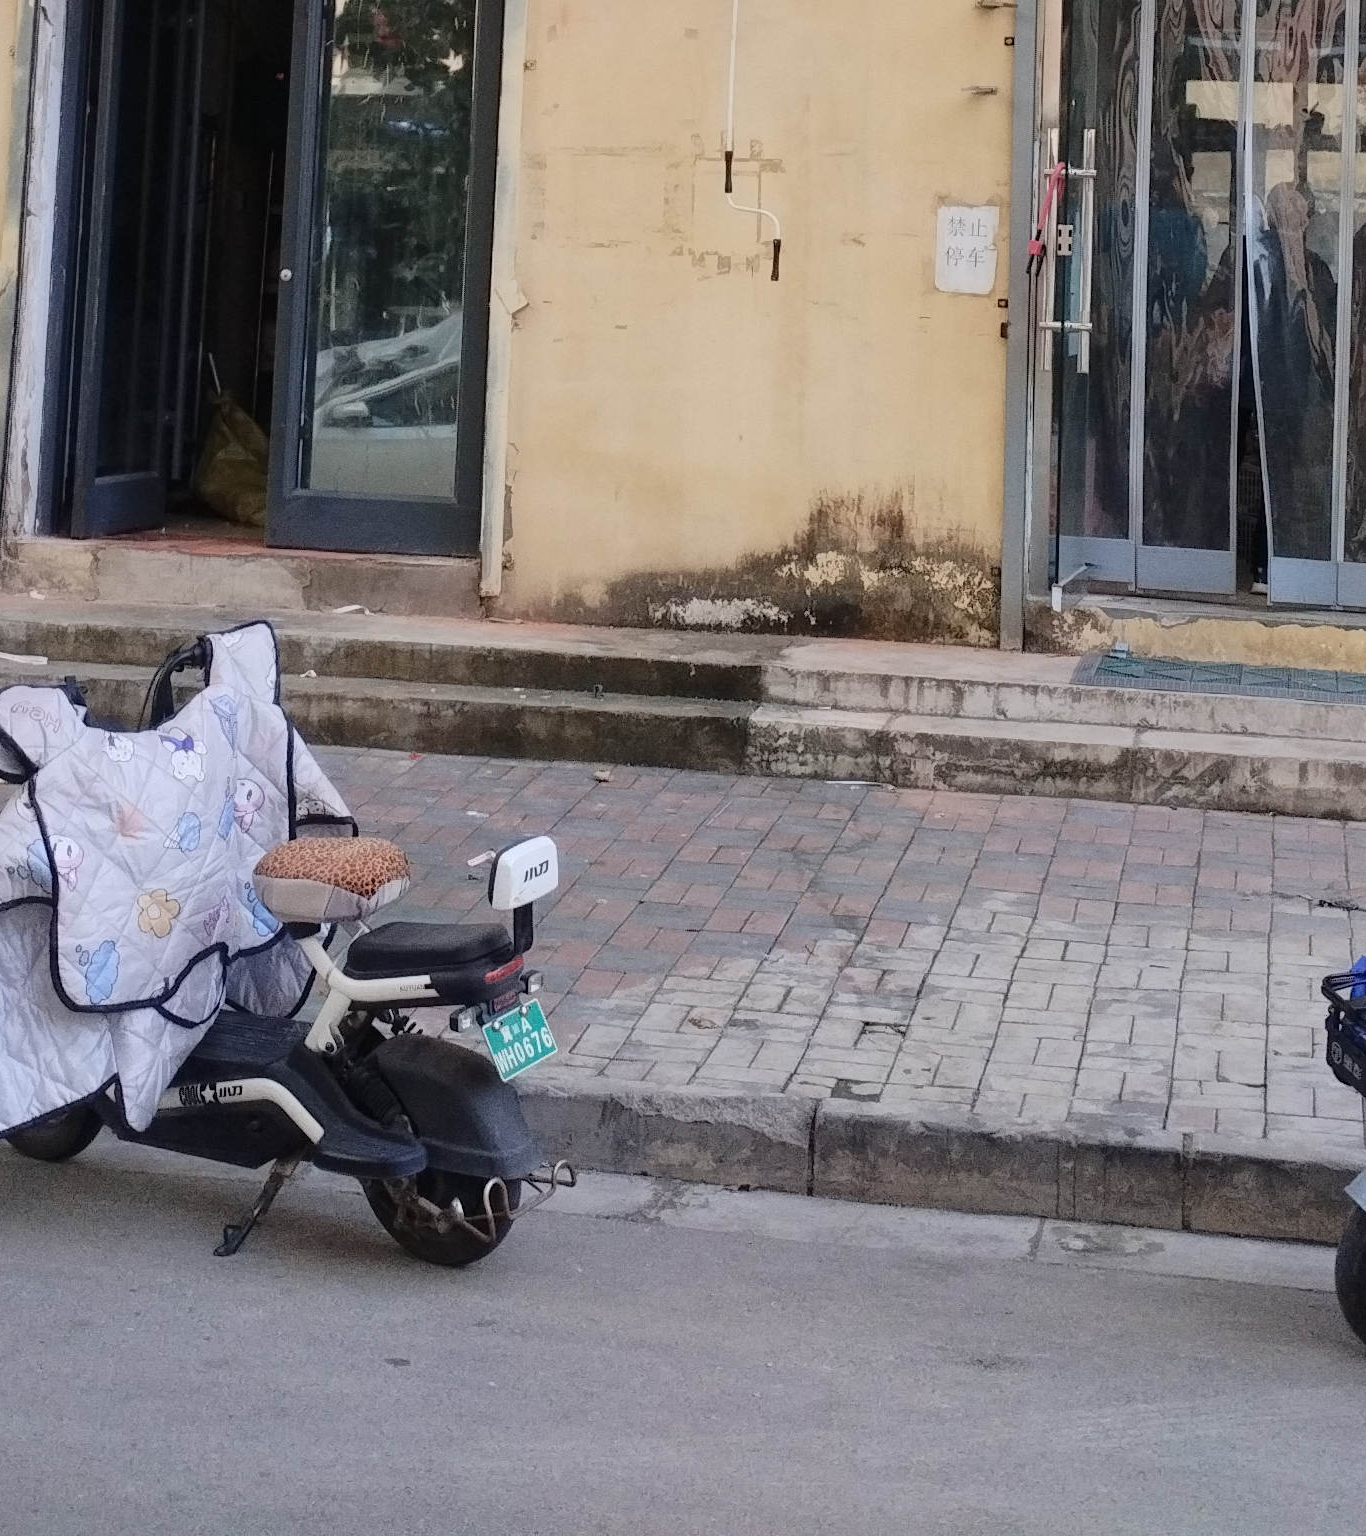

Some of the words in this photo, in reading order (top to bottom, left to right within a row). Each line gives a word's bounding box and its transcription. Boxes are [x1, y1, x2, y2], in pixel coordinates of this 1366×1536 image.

[947, 216, 988, 238] 禁止
[944, 245, 985, 268] 停车
[495, 1027, 553, 1074] WH0676
